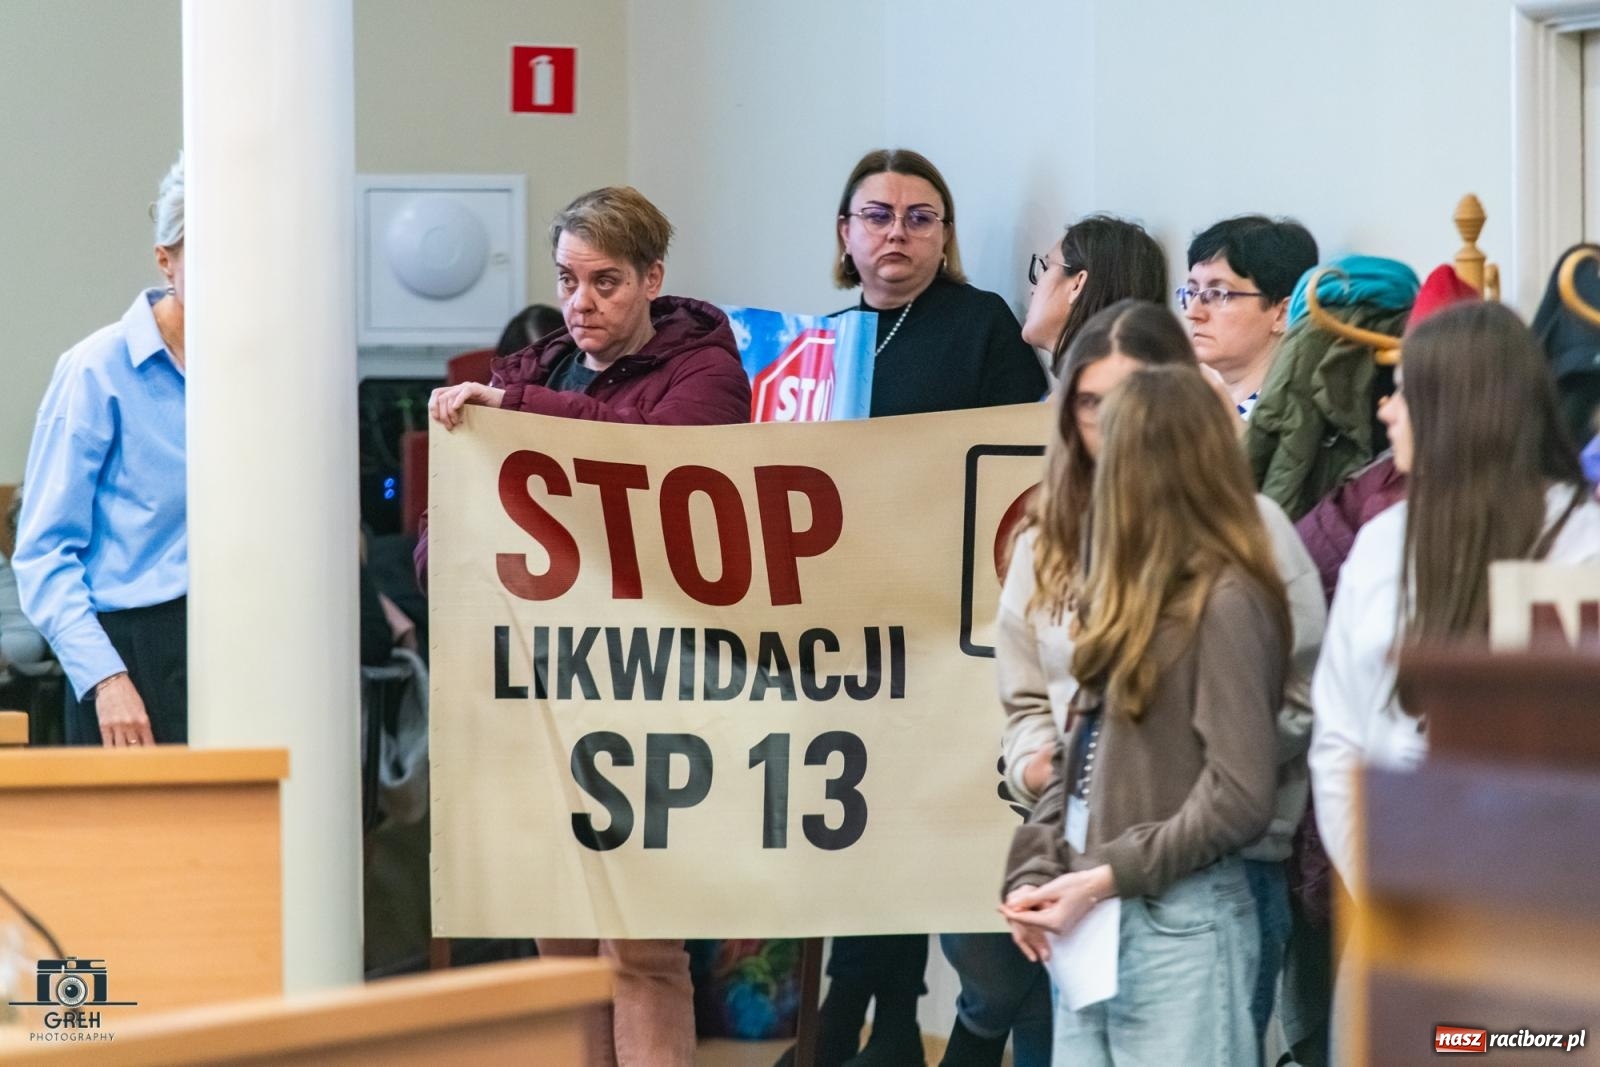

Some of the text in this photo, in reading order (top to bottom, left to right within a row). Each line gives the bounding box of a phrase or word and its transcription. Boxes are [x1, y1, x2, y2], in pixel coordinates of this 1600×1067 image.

[496, 449, 843, 606] STOP
[494, 625, 906, 702] LIKWIDACJI
[570, 730, 713, 851] SP
[748, 730, 868, 850] 13
